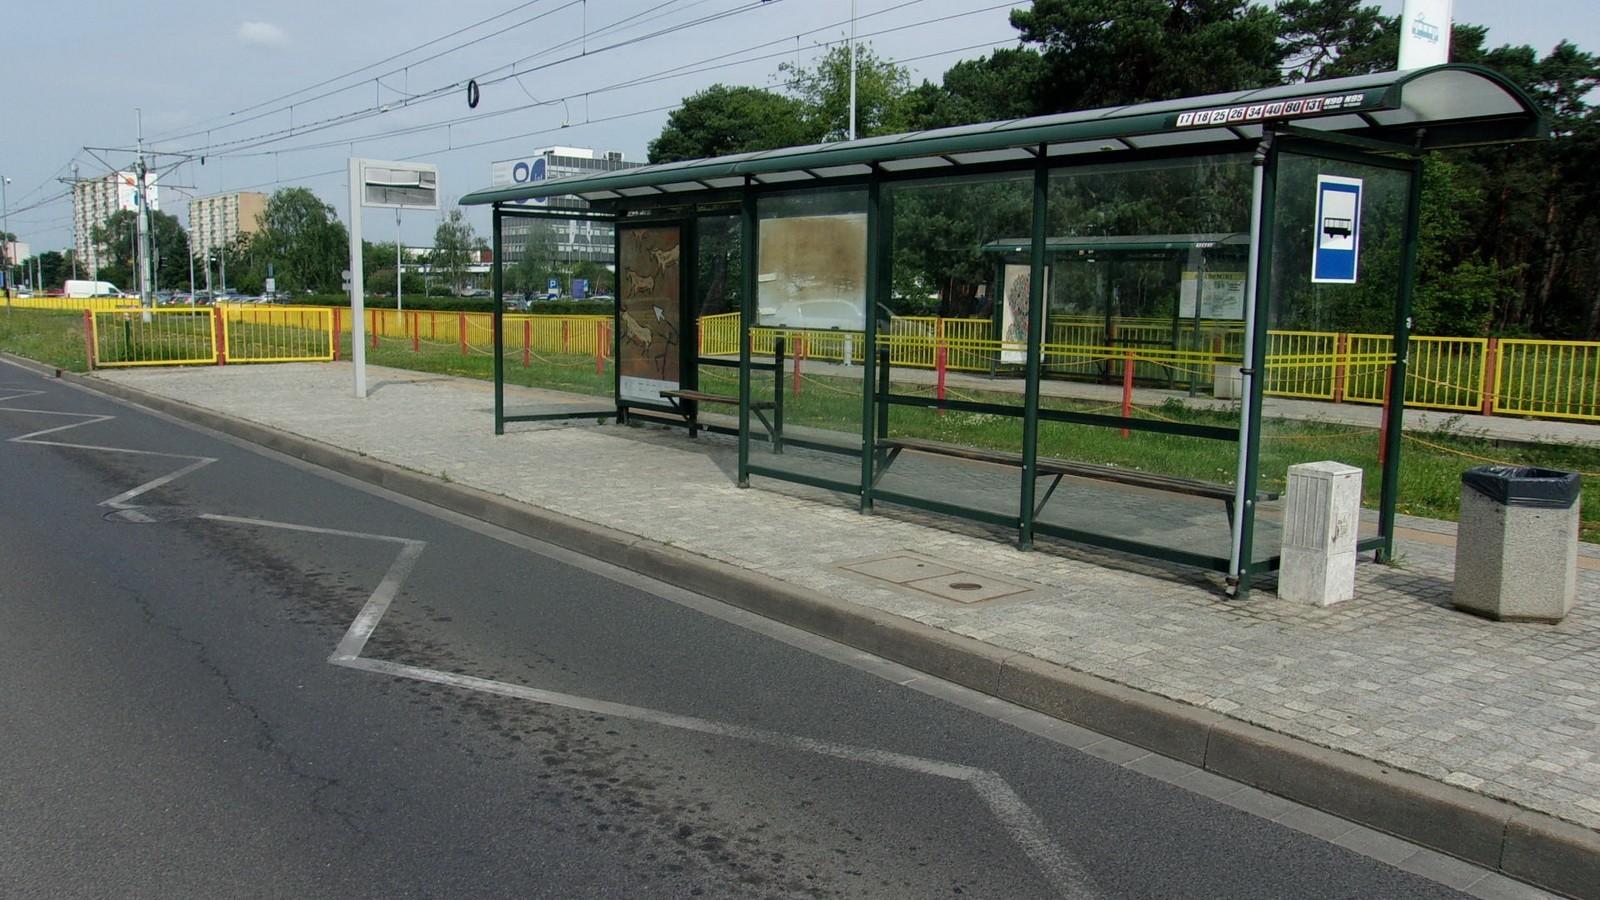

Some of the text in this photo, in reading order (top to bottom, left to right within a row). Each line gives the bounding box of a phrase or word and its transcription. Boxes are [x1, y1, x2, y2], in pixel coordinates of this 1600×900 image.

[1180, 114, 1191, 123] 17
[1198, 112, 1209, 122] 18
[1214, 111, 1225, 120] 25
[1231, 109, 1242, 118] 26
[1248, 107, 1261, 116] 34
[1266, 105, 1280, 115] 40
[1306, 100, 1321, 110] 131
